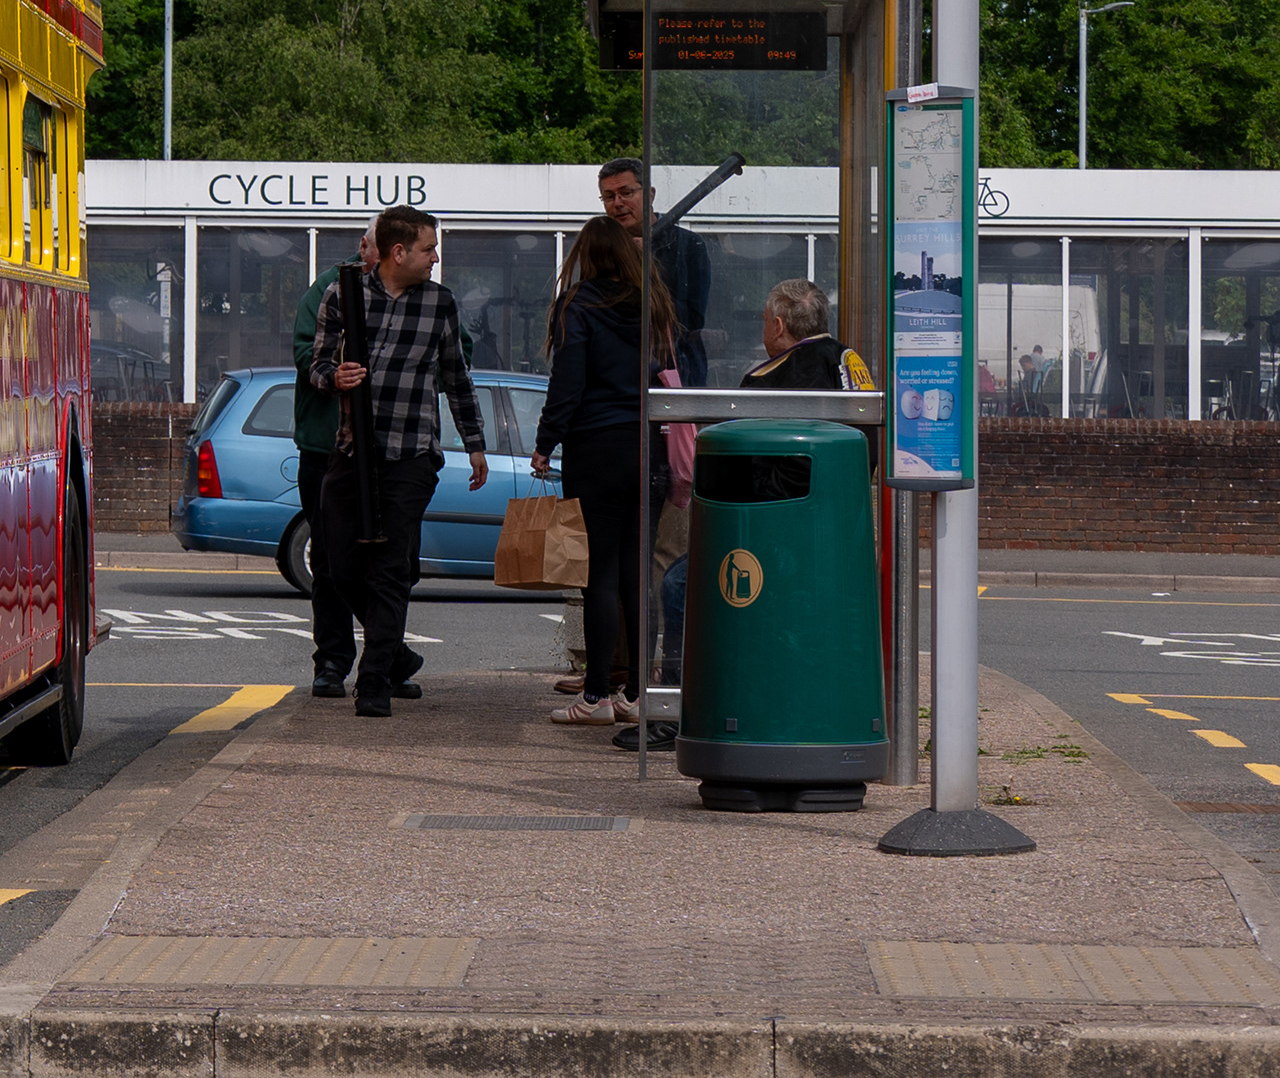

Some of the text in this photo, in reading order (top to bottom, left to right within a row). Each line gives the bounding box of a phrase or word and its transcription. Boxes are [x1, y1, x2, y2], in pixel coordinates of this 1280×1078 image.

[658, 18, 766, 28] Please refer to the
[658, 34, 766, 45] published timetable
[767, 50, 797, 60] 09:49
[208, 174, 428, 206] CYCLE HUB
[896, 233, 961, 243] SURREY HILLS
[909, 318, 947, 326] LEITH HILL
[910, 370, 921, 378] you
